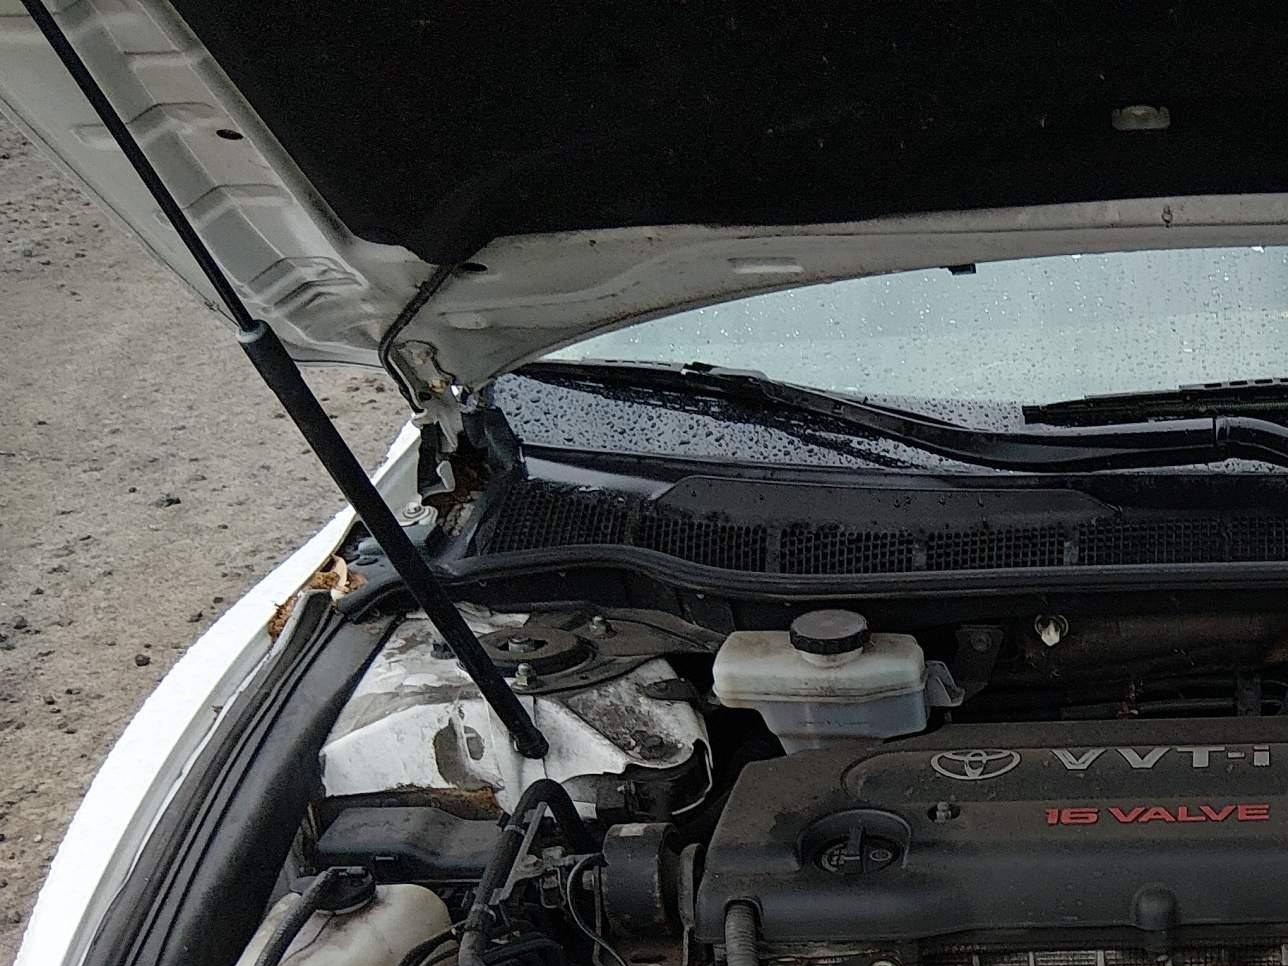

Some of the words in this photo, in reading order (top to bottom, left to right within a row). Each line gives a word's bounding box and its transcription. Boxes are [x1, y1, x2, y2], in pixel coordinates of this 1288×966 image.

[1051, 745, 1270, 770] VVT-i
[1046, 807, 1100, 825] 16
[1107, 804, 1271, 824] VALVE
